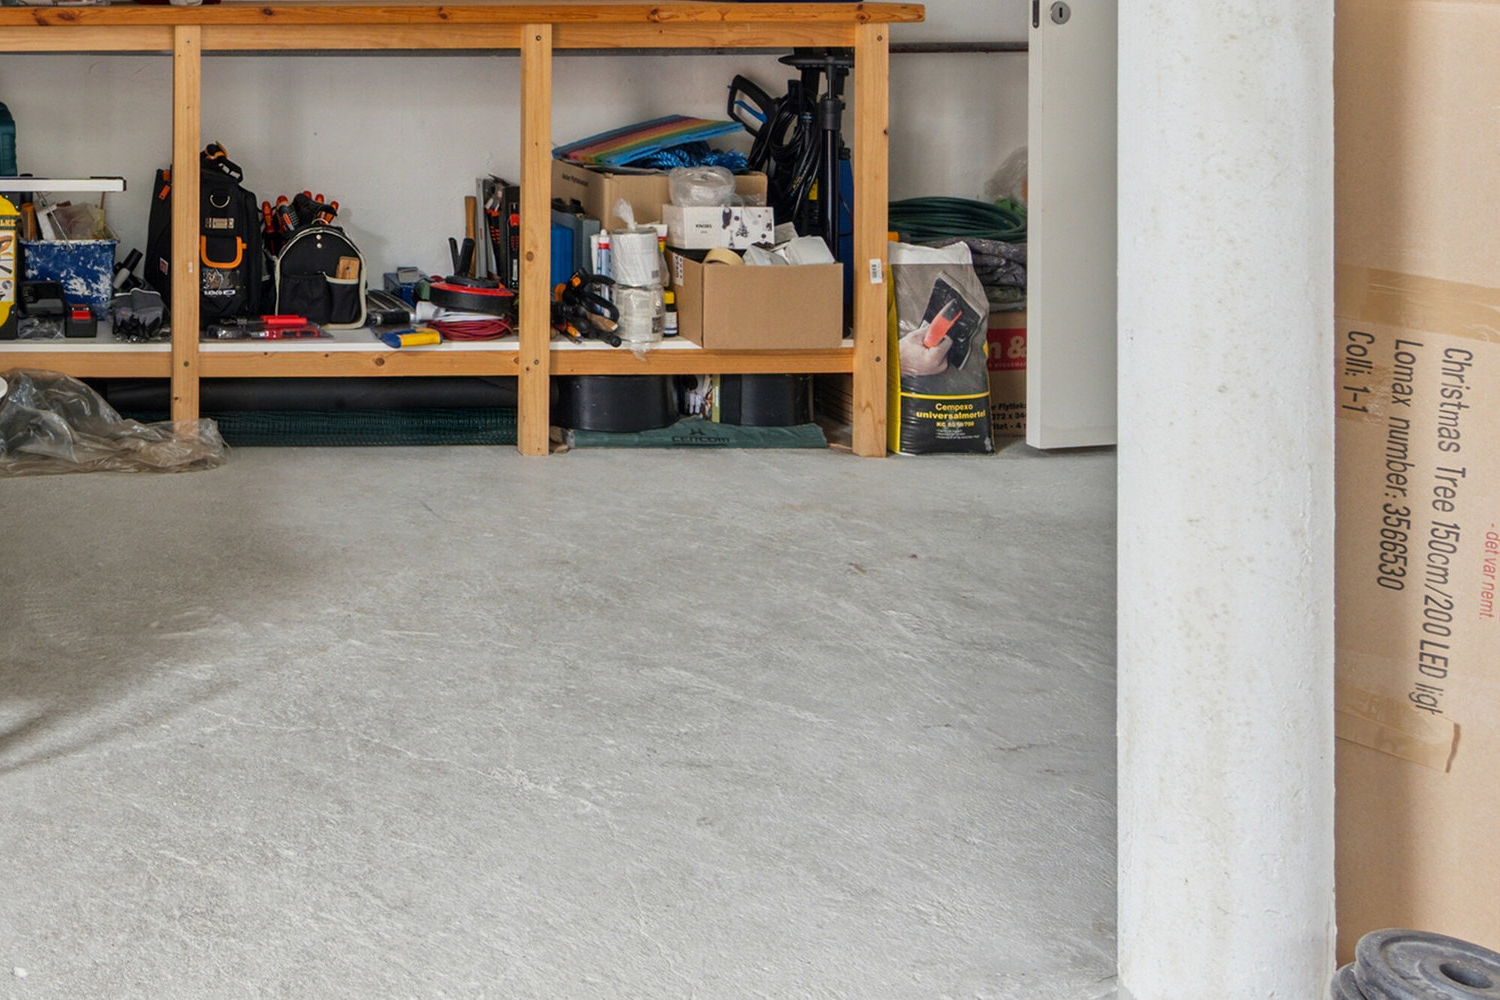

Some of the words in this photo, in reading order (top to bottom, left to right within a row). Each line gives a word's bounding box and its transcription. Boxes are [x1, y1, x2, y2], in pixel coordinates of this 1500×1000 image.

[1345, 329, 1375, 379] Colli:
[1391, 338, 1424, 407] Lomax
[1342, 385, 1370, 414] 1-1
[1438, 346, 1473, 454] Christmas
[1386, 416, 1415, 498] number:
[1432, 464, 1467, 513] Tree
[1377, 500, 1412, 592] 3566530
[1484, 531, 1500, 555] det
[1423, 520, 1461, 638] 150cm/200
[1482, 557, 1497, 580] var
[1417, 638, 1449, 680] LED
